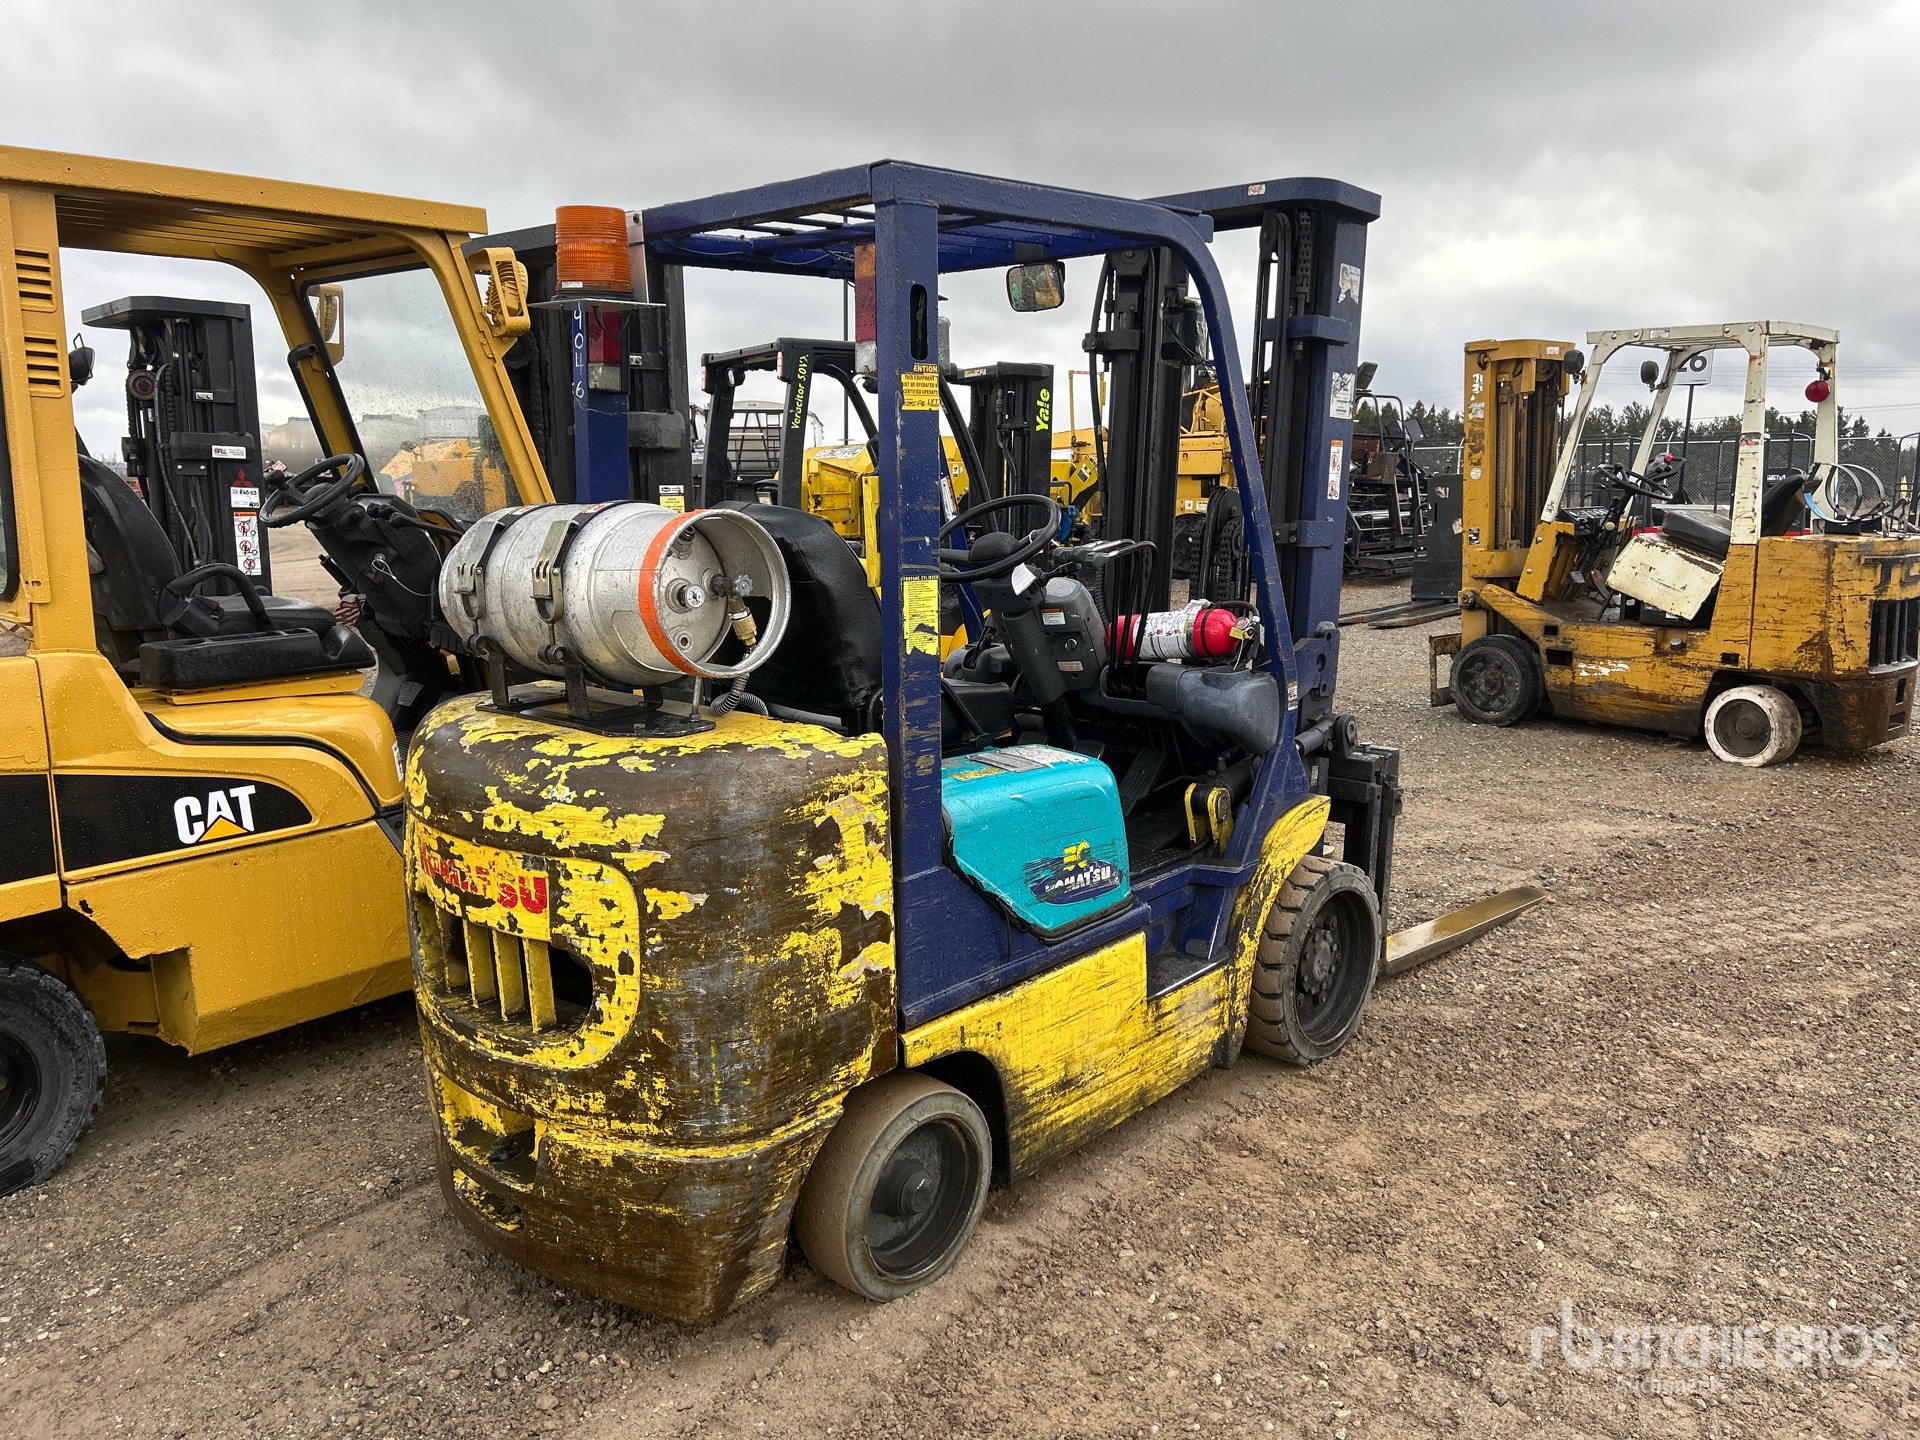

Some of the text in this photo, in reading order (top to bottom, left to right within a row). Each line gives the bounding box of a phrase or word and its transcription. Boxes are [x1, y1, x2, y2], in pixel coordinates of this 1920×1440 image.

[1677, 355, 1707, 372] 6
[1036, 388, 1050, 431] Yale
[173, 784, 256, 845] CAT
